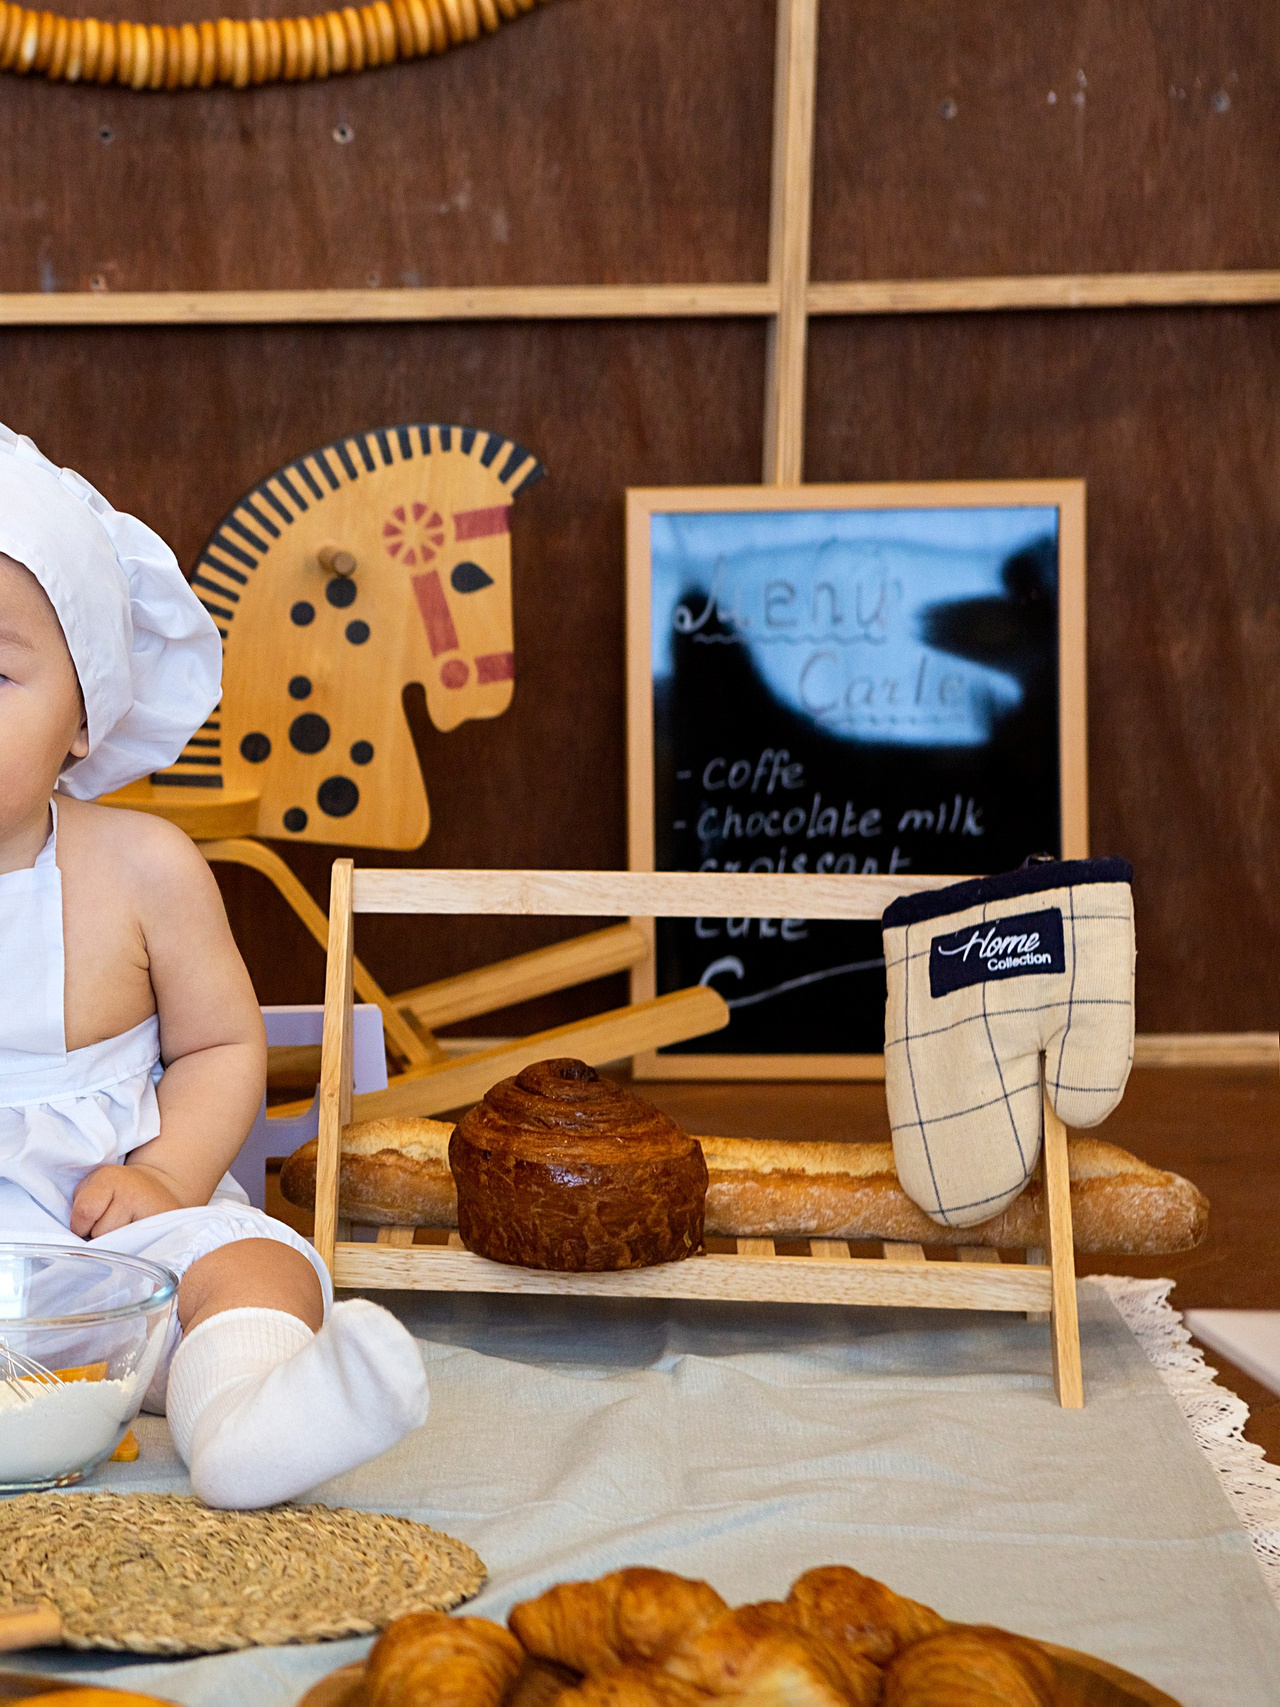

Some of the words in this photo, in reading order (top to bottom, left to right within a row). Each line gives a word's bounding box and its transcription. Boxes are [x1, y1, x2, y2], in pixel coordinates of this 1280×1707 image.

[697, 792, 883, 839] chocolate
[897, 794, 985, 837] milk
[938, 926, 1041, 963] Home
[987, 952, 1052, 972] Collection
